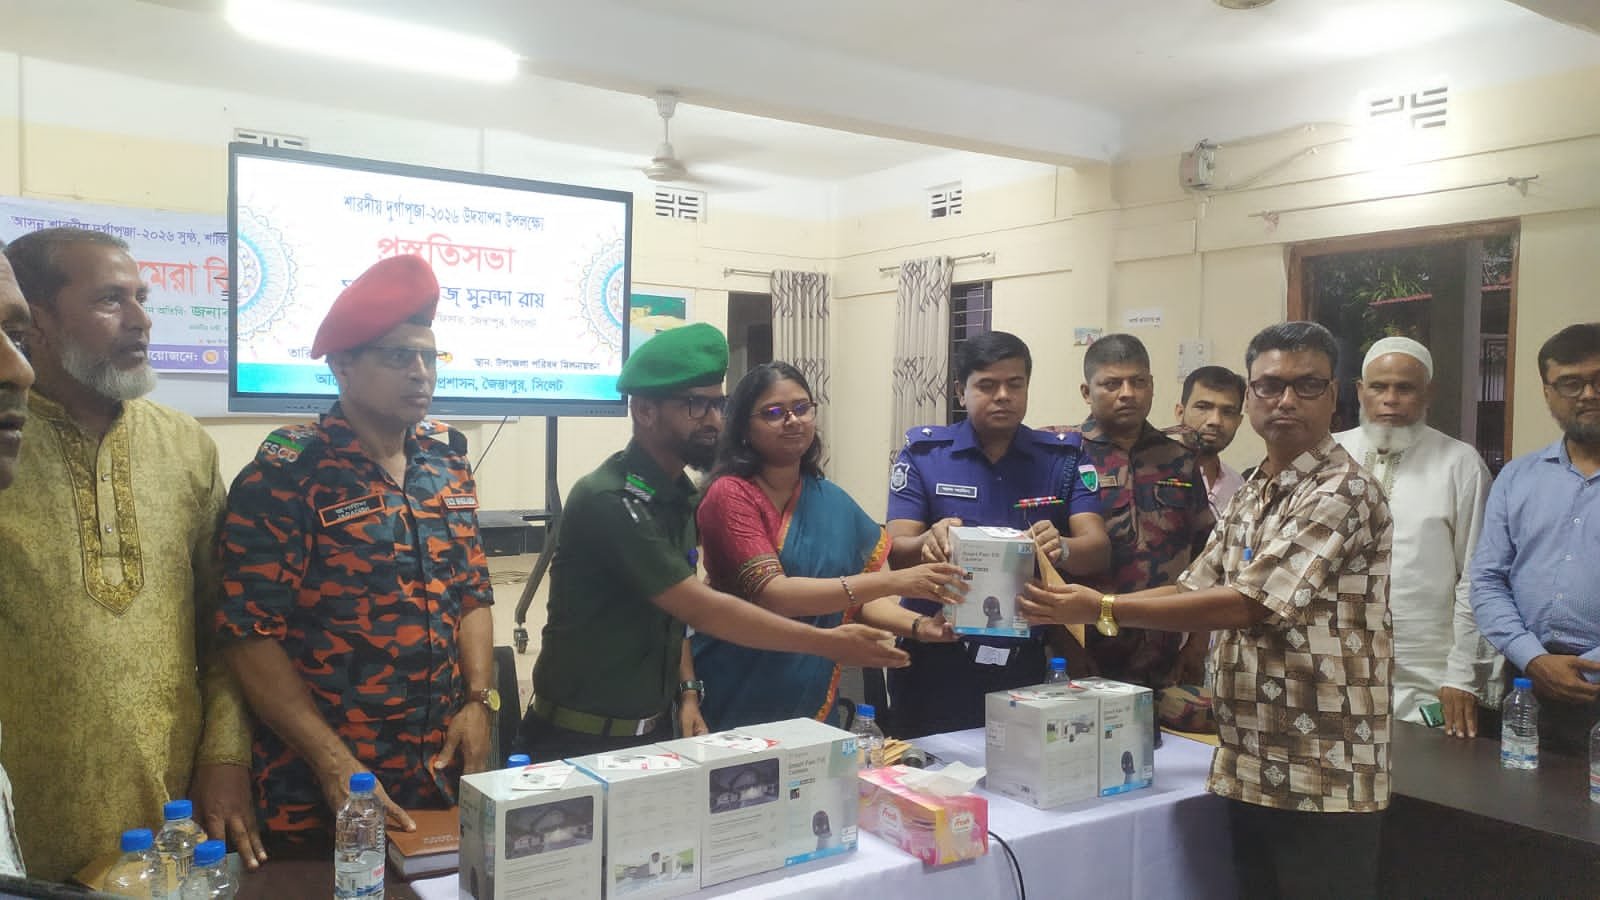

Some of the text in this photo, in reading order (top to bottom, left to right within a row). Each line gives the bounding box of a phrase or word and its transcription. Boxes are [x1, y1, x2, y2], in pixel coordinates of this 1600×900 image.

[343, 193, 383, 214] শারদীয়
[467, 287, 513, 308] সুনন্দা
[517, 291, 545, 308] রায়
[532, 377, 565, 392] সিলেট
